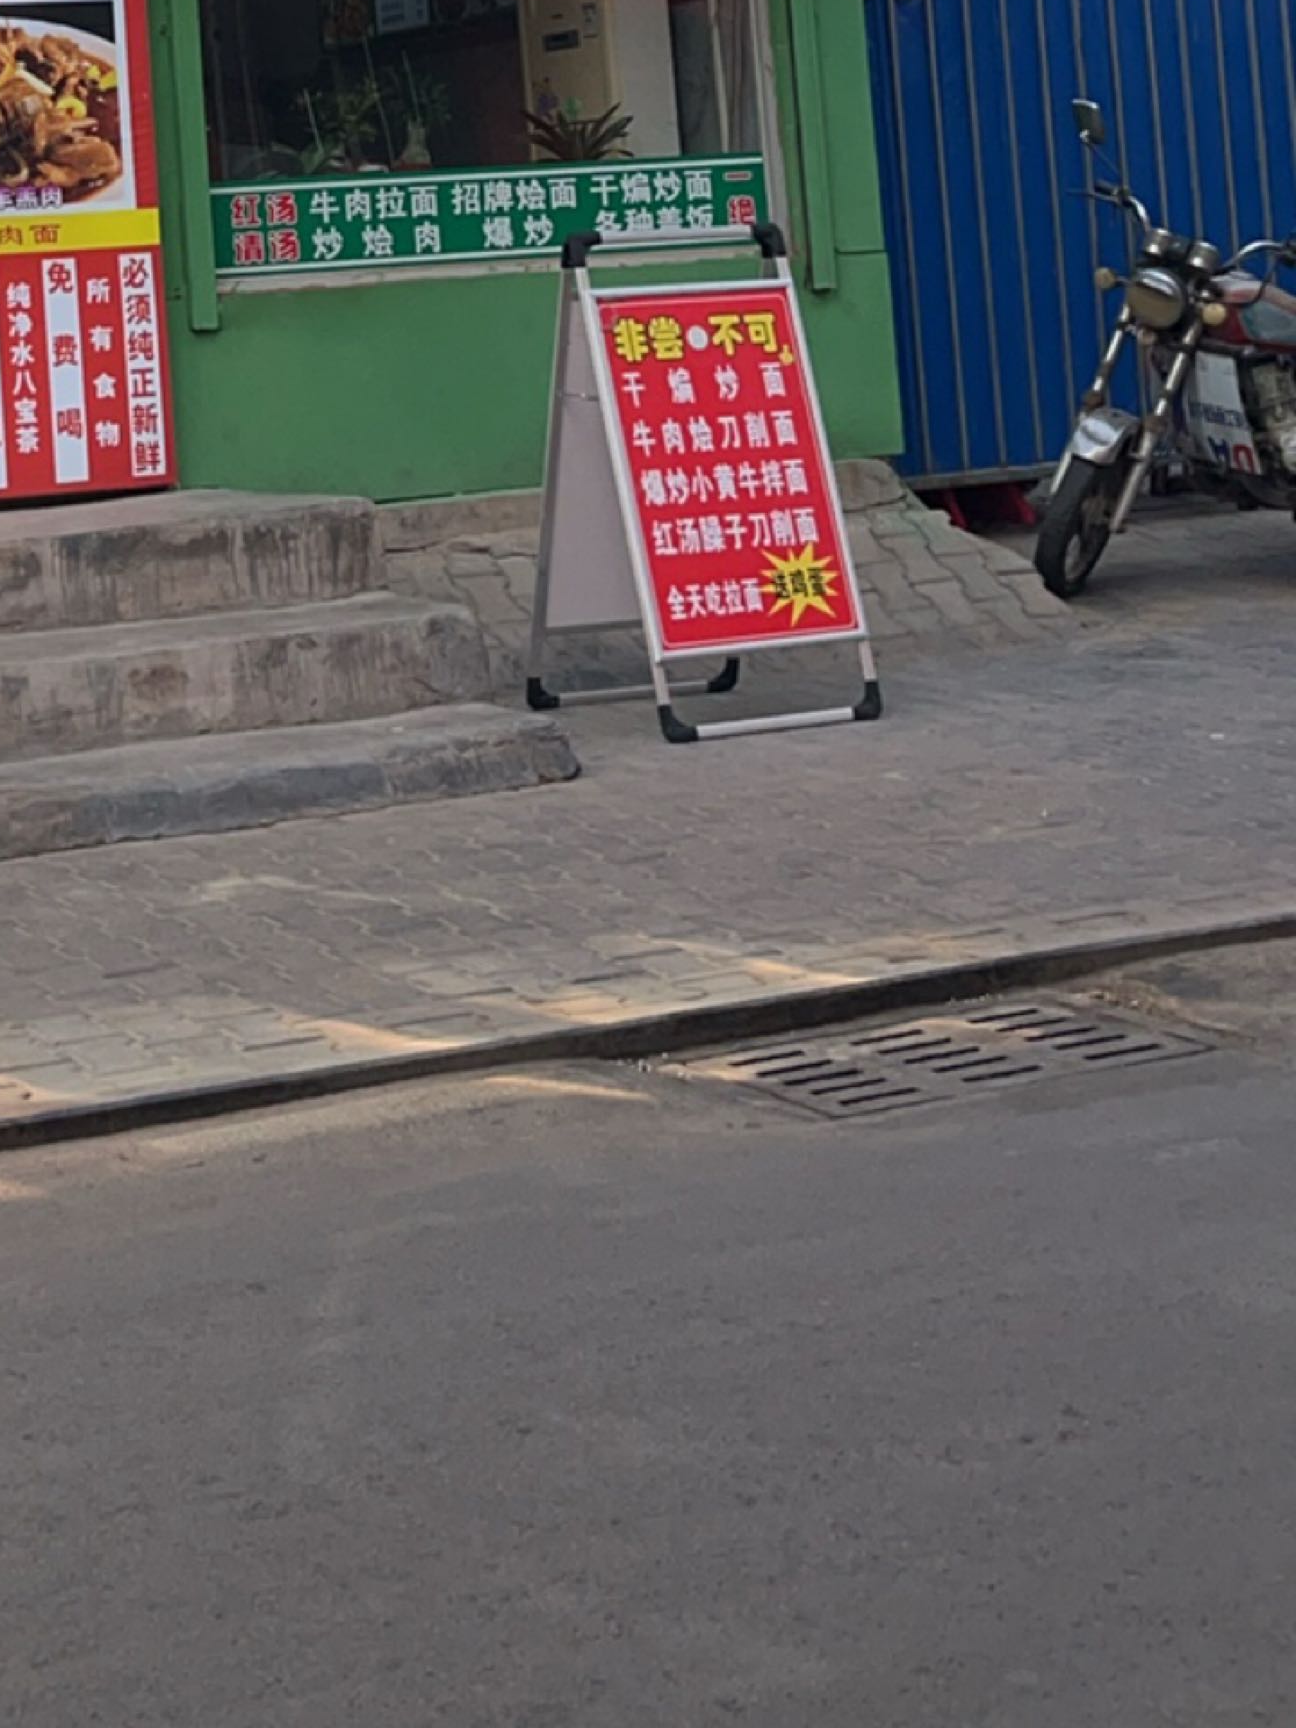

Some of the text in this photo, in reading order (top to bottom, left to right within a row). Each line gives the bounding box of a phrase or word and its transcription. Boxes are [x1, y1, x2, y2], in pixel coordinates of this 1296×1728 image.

[231, 192, 298, 229] 红汤
[309, 184, 440, 223] 牛肉拉面
[451, 177, 578, 215] 招牌烩面
[311, 221, 442, 260] 炒烩肉
[482, 213, 554, 249] 爆炒
[6, 282, 41, 454] 纯净水八宝茶
[47, 262, 84, 440] 免费喝
[86, 278, 121, 448] 所有食物
[122, 259, 162, 473] 必须纯正新鲜
[667, 577, 765, 620] 全天吃拉面
